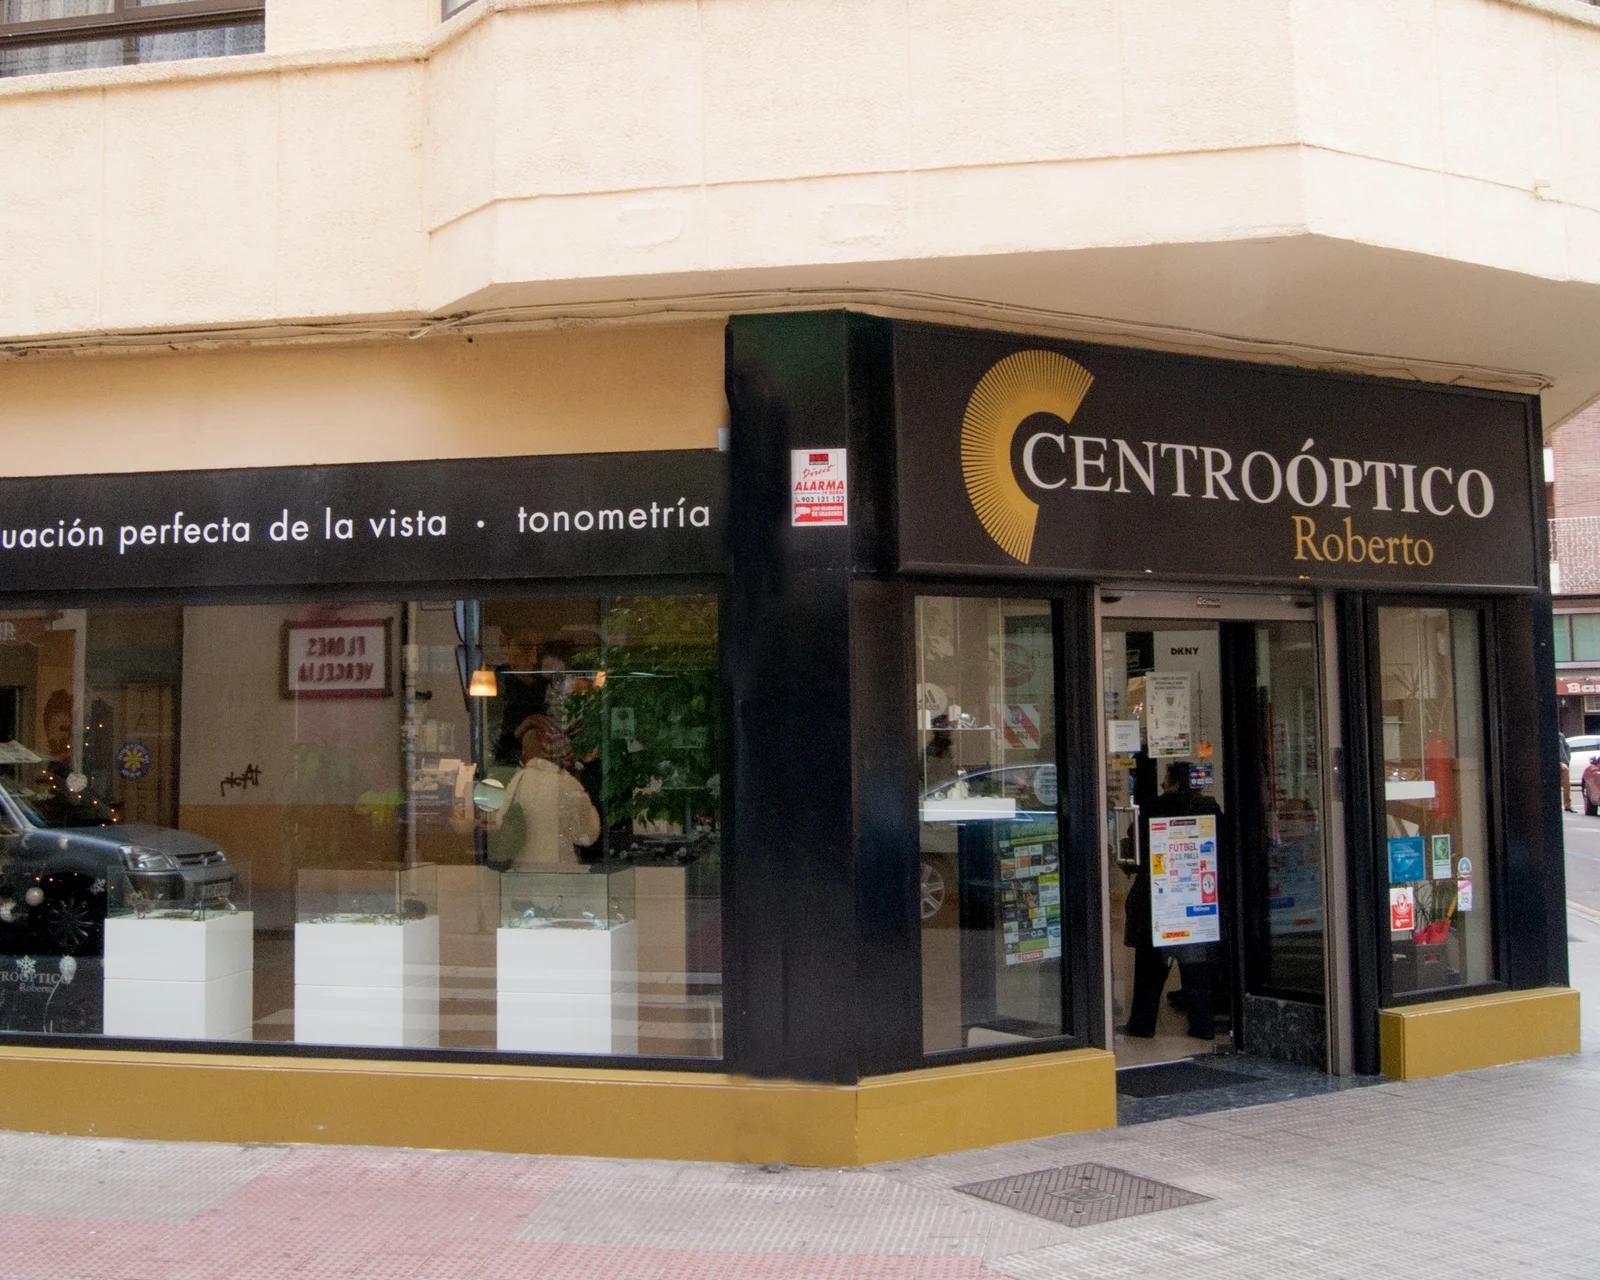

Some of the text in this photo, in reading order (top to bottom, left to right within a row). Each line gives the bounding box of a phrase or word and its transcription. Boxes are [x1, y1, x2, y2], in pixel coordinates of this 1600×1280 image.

[794, 480, 845, 491] ALARMA
[1022, 432, 1495, 519] CENTROÓPTICO
[119, 511, 251, 555] perfecta
[269, 508, 309, 542] de
[325, 506, 354, 540] la
[368, 508, 447, 539] vista
[517, 496, 710, 533] tonometría
[1291, 515, 1435, 567] Roberto
[1170, 647, 1199, 656] DKNY
